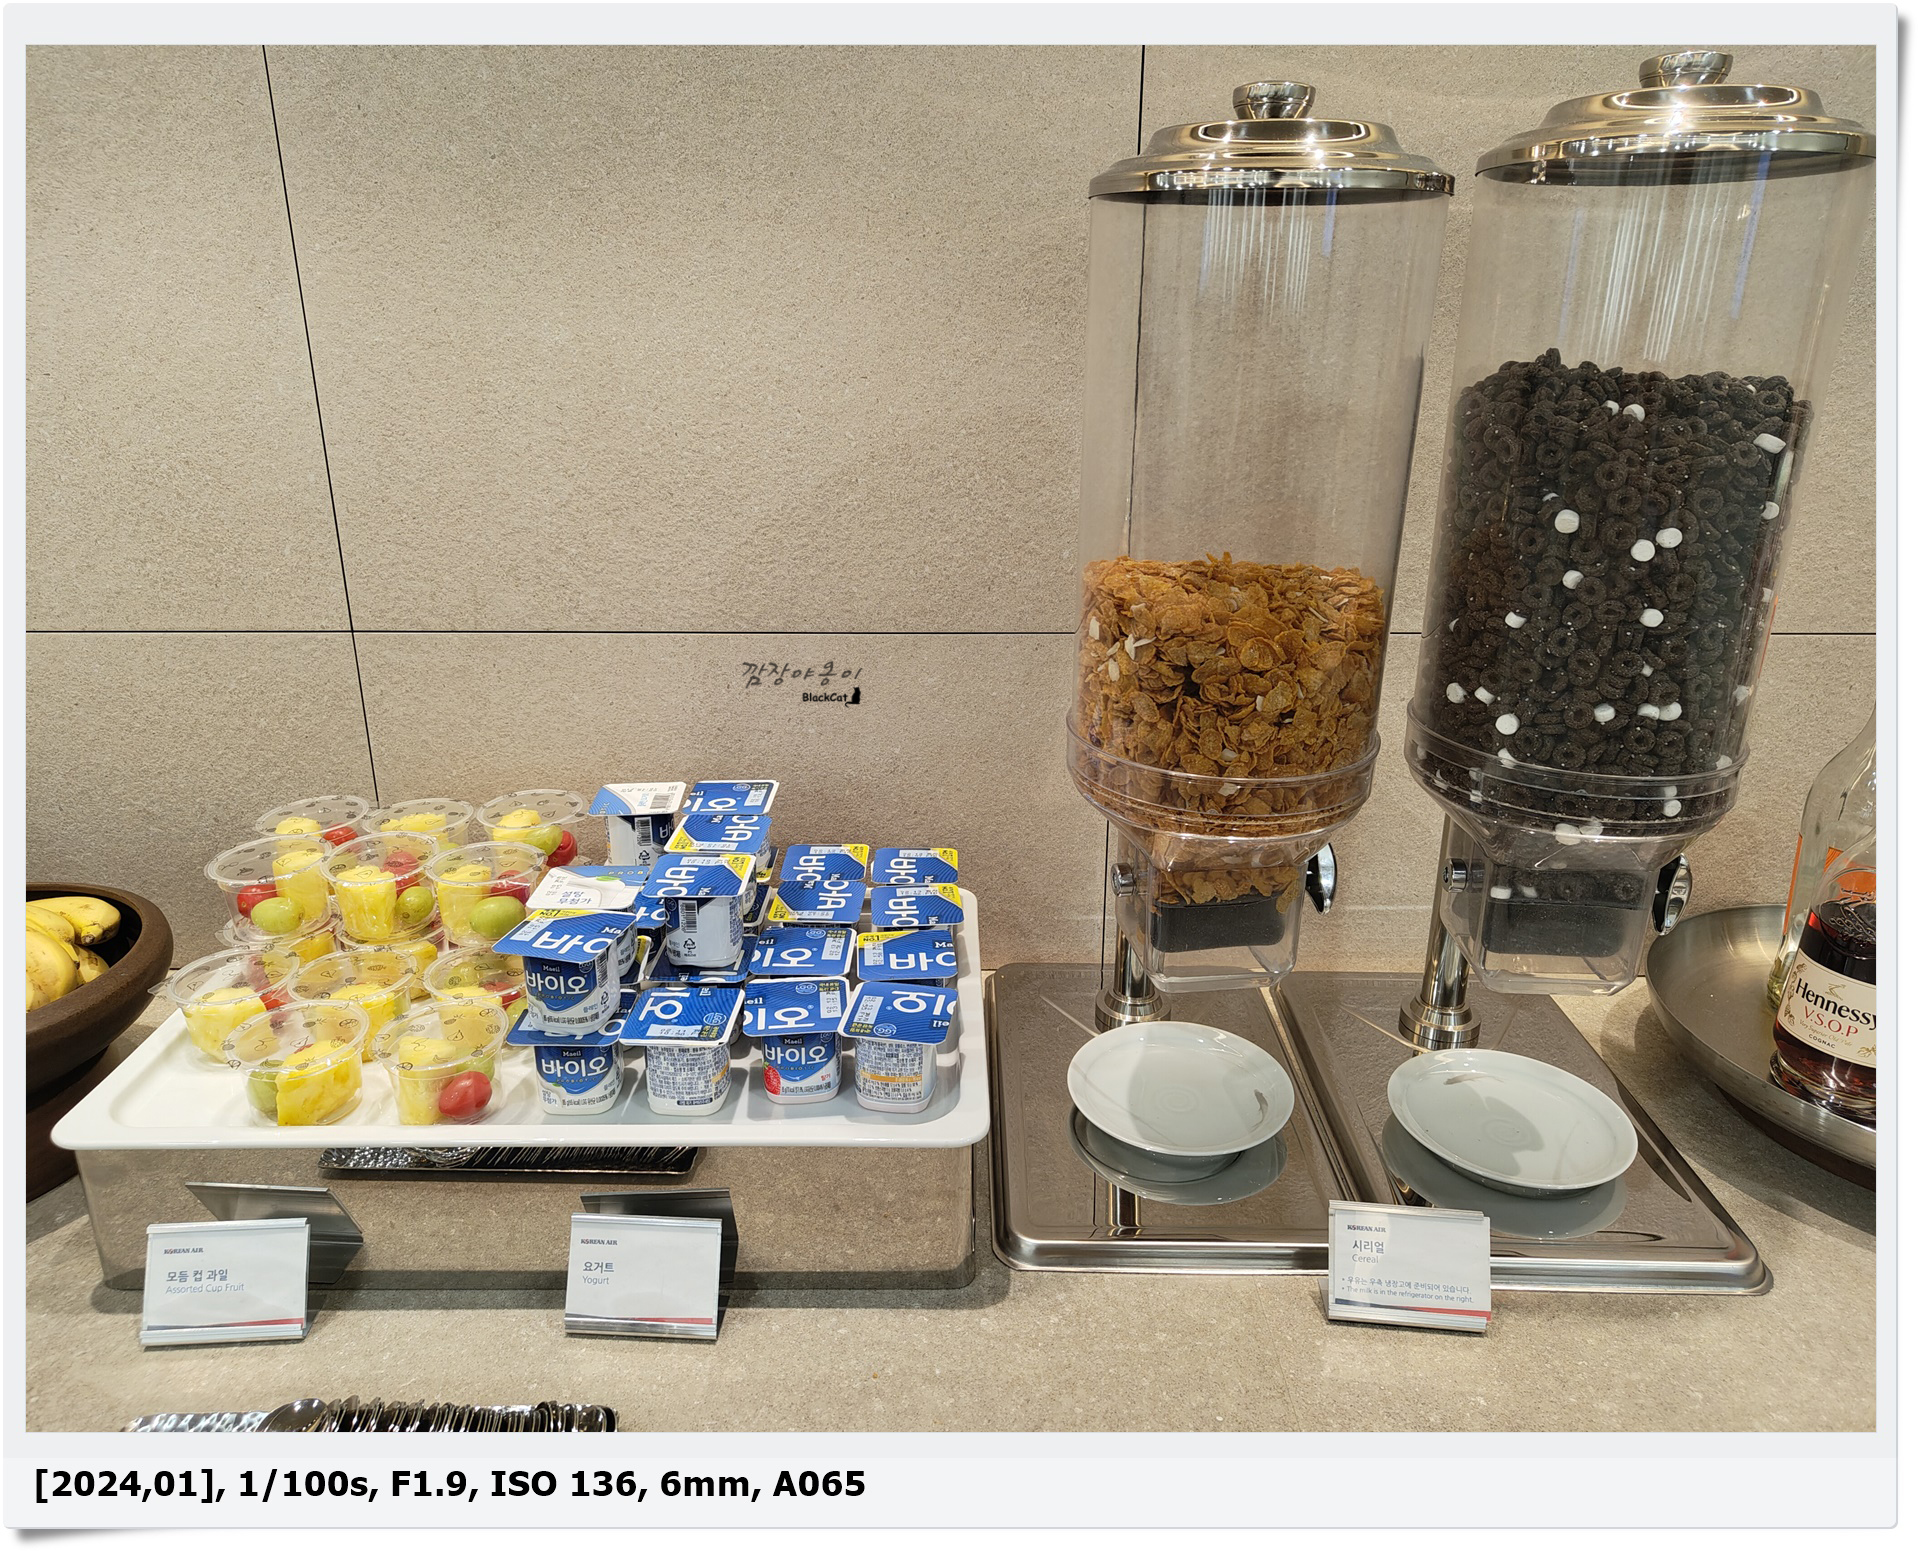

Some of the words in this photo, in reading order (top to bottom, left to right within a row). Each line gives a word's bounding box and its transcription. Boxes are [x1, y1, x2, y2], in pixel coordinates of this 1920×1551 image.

[526, 970, 589, 994] 바이오
[1805, 1005, 1858, 1037] V.S.O.P
[1808, 1033, 1836, 1049] COGNAC
[765, 1044, 828, 1065] 바이오
[542, 1057, 608, 1077] 바이오
[1352, 1239, 1384, 1254] 시리얼
[1351, 1254, 1379, 1264] Cereal
[166, 1270, 190, 1282] 모듬
[193, 1270, 203, 1282] 컵
[206, 1268, 228, 1281] 과일
[582, 1261, 615, 1274] 요거트
[582, 1275, 610, 1285] Yogurt
[1347, 1276, 1368, 1285] 우유는
[1369, 1277, 1383, 1287] 우측
[1384, 1280, 1412, 1290] 냉장고에
[1413, 1282, 1441, 1291] 준비되어
[165, 1284, 204, 1295] Assorted
[205, 1283, 223, 1293] Cup
[225, 1282, 245, 1292] Fruit
[1399, 1290, 1434, 1300] refrigerator
